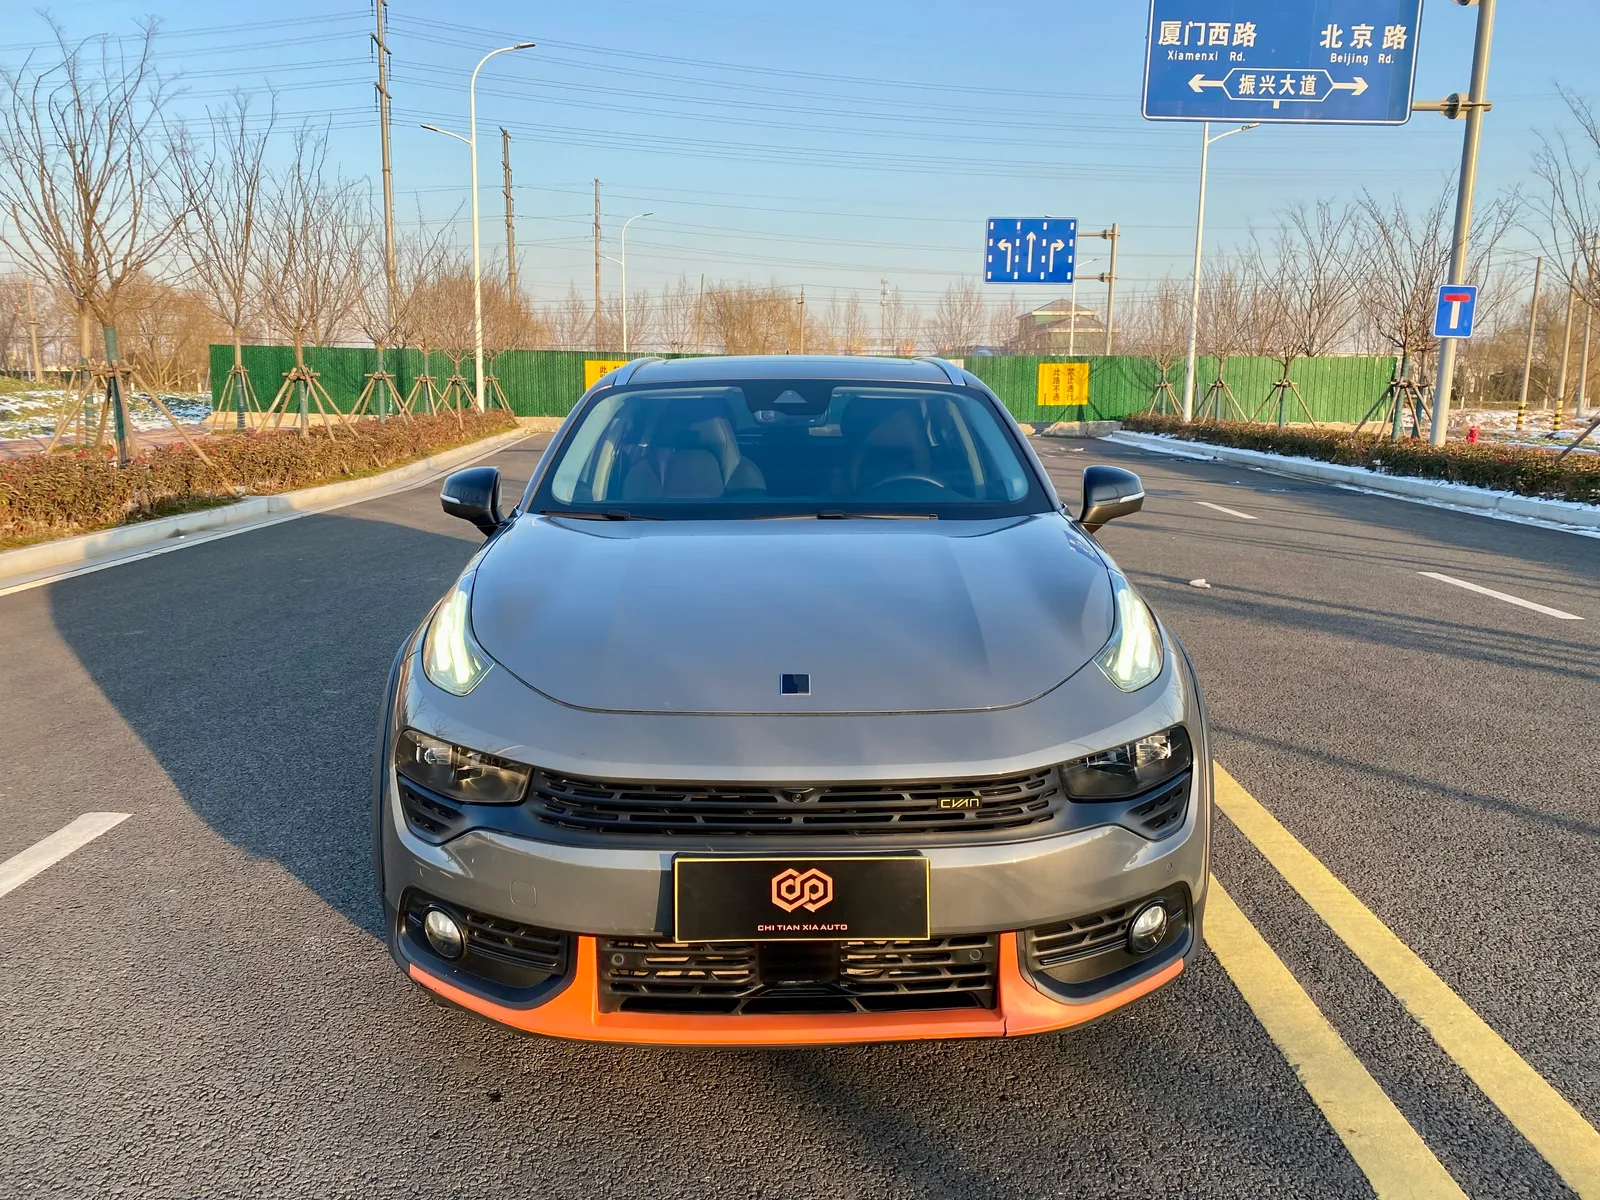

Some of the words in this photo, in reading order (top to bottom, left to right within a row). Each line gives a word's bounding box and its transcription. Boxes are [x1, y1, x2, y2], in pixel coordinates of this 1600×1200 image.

[1158, 20, 1257, 47] 厦门西路
[1319, 23, 1407, 49] 北京路
[1167, 50, 1218, 61] Xiamenxi
[1229, 51, 1246, 62] Rd.
[1330, 52, 1368, 66] Beijing
[1378, 53, 1394, 64] Rd.
[1238, 74, 1317, 95] 振兴大道
[820, 923, 848, 931] AUTO
